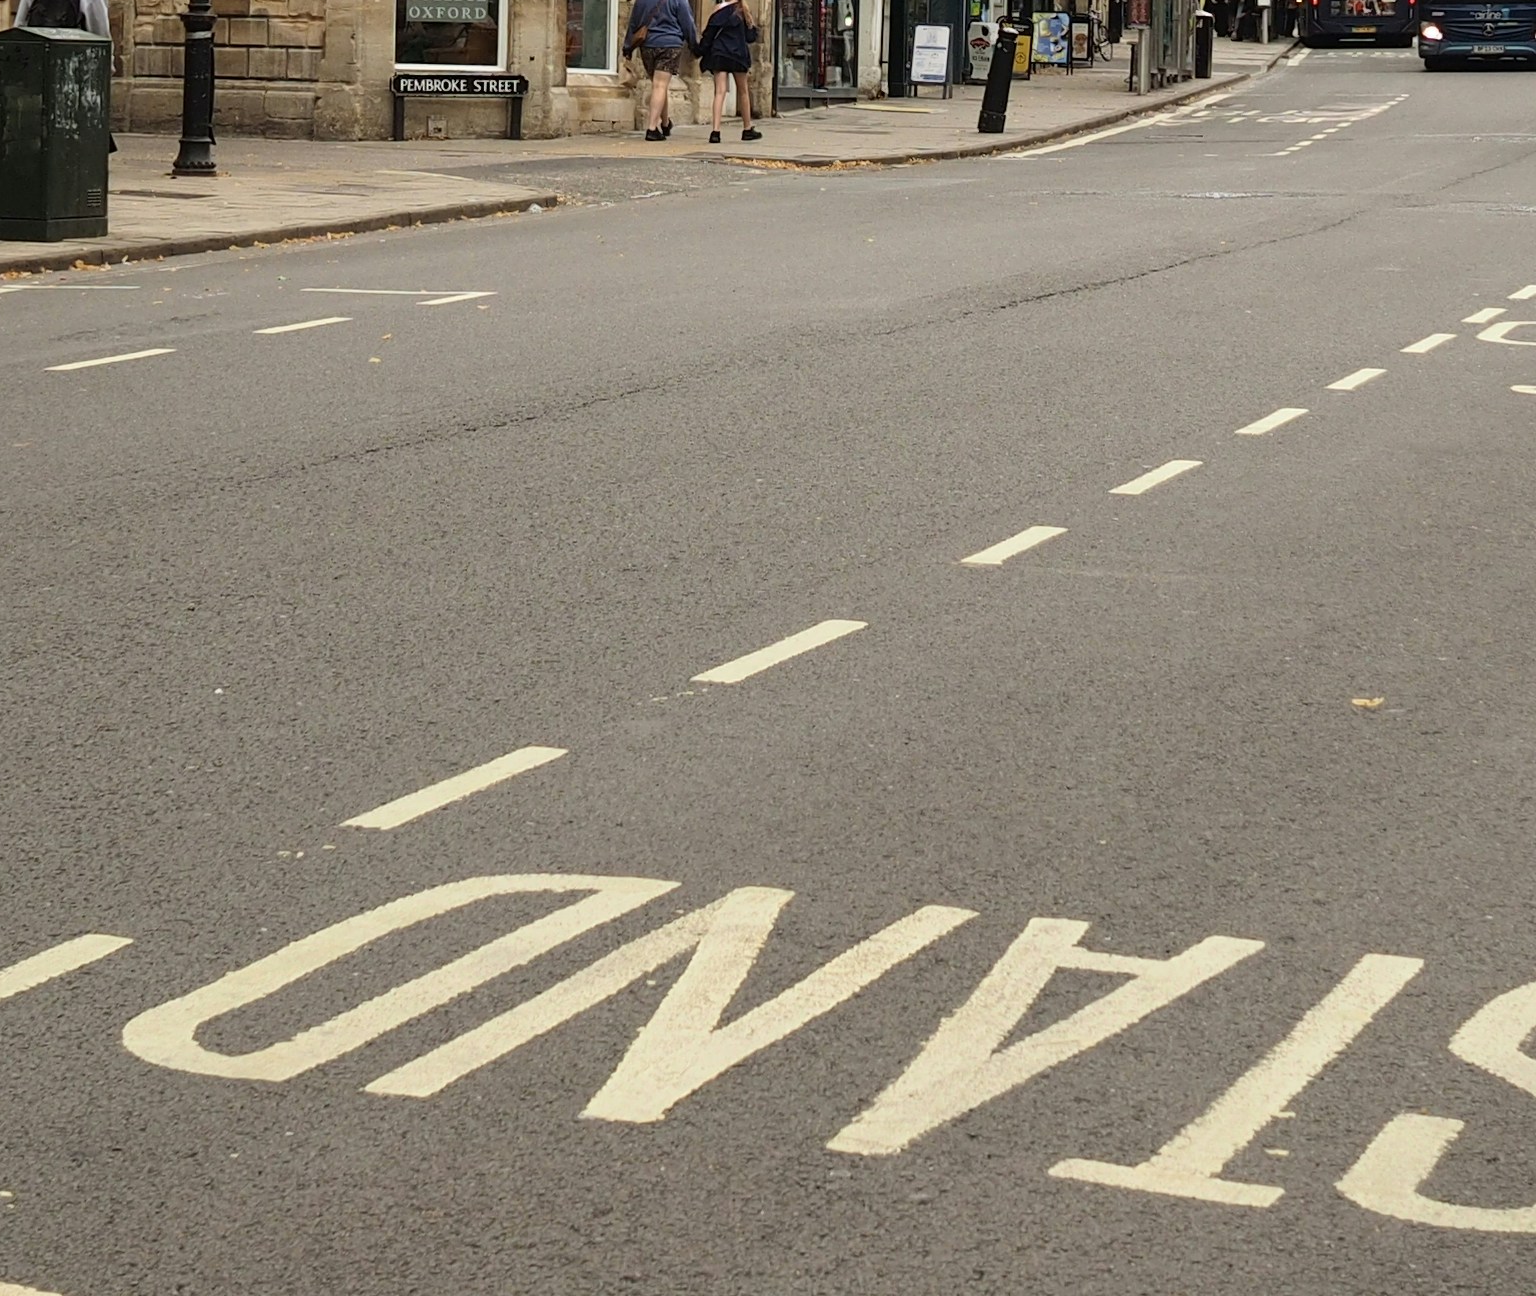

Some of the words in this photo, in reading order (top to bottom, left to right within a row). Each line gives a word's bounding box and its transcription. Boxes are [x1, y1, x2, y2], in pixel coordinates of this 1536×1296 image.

[409, 5, 487, 20] OXFORD
[399, 78, 468, 92] PEMBROKE
[473, 79, 520, 93] STREET
